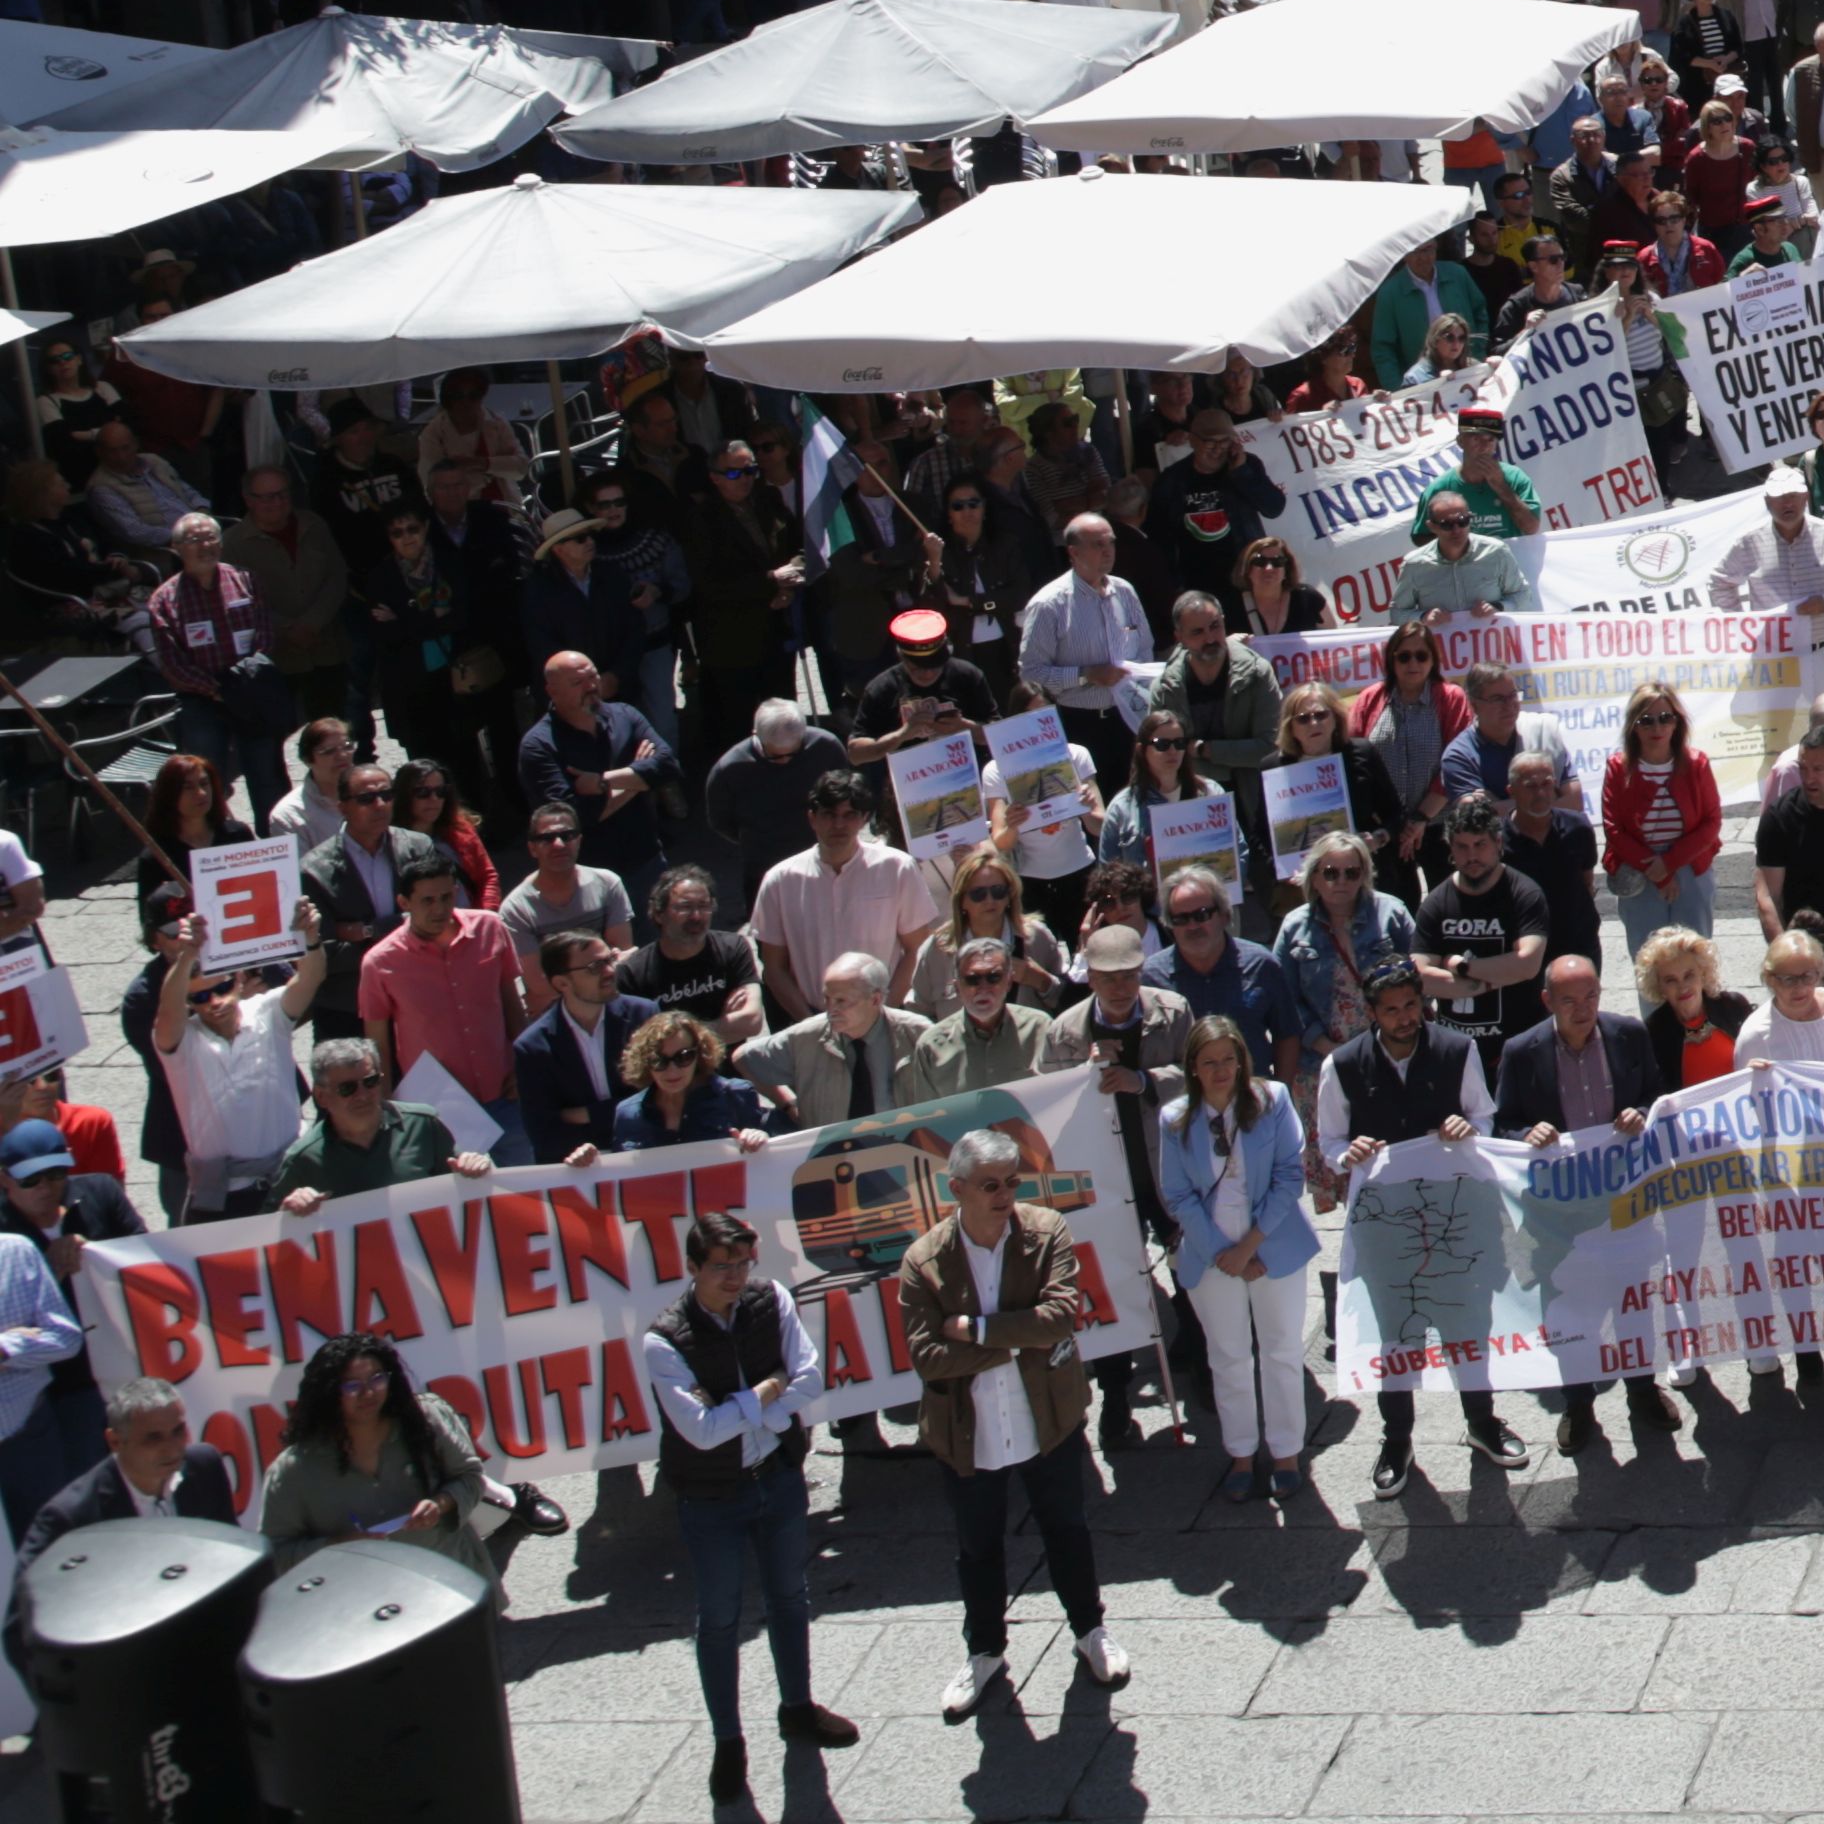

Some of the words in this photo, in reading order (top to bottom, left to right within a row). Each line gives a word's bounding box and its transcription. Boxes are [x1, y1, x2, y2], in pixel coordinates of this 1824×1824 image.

[1714, 348, 1779, 409] QUE
[1727, 412, 1751, 455] Y
[1664, 587, 1702, 612] LA
[1532, 625, 1568, 661] EN
[1578, 619, 1654, 659] TODO
[1661, 618, 1697, 655] EL
[1703, 616, 1794, 654] OESTE
[1036, 715, 1056, 727] NO
[945, 741, 966, 755] NO
[1315, 763, 1336, 776] NO
[1206, 804, 1228, 816] NO
[223, 843, 289, 862] MOMENTO!
[1441, 918, 1505, 935] GORA
[261, 939, 298, 951] CUENTA
[1528, 1078, 1824, 1203] CONCENTRACIÓN
[1620, 1264, 1717, 1316] APOYA
[1726, 1261, 1764, 1298] LA
[1600, 1337, 1663, 1374] DEL
[1667, 1321, 1738, 1363] TREN
[1745, 1314, 1788, 1351] DE
[1368, 1340, 1483, 1381] SÚBETE
